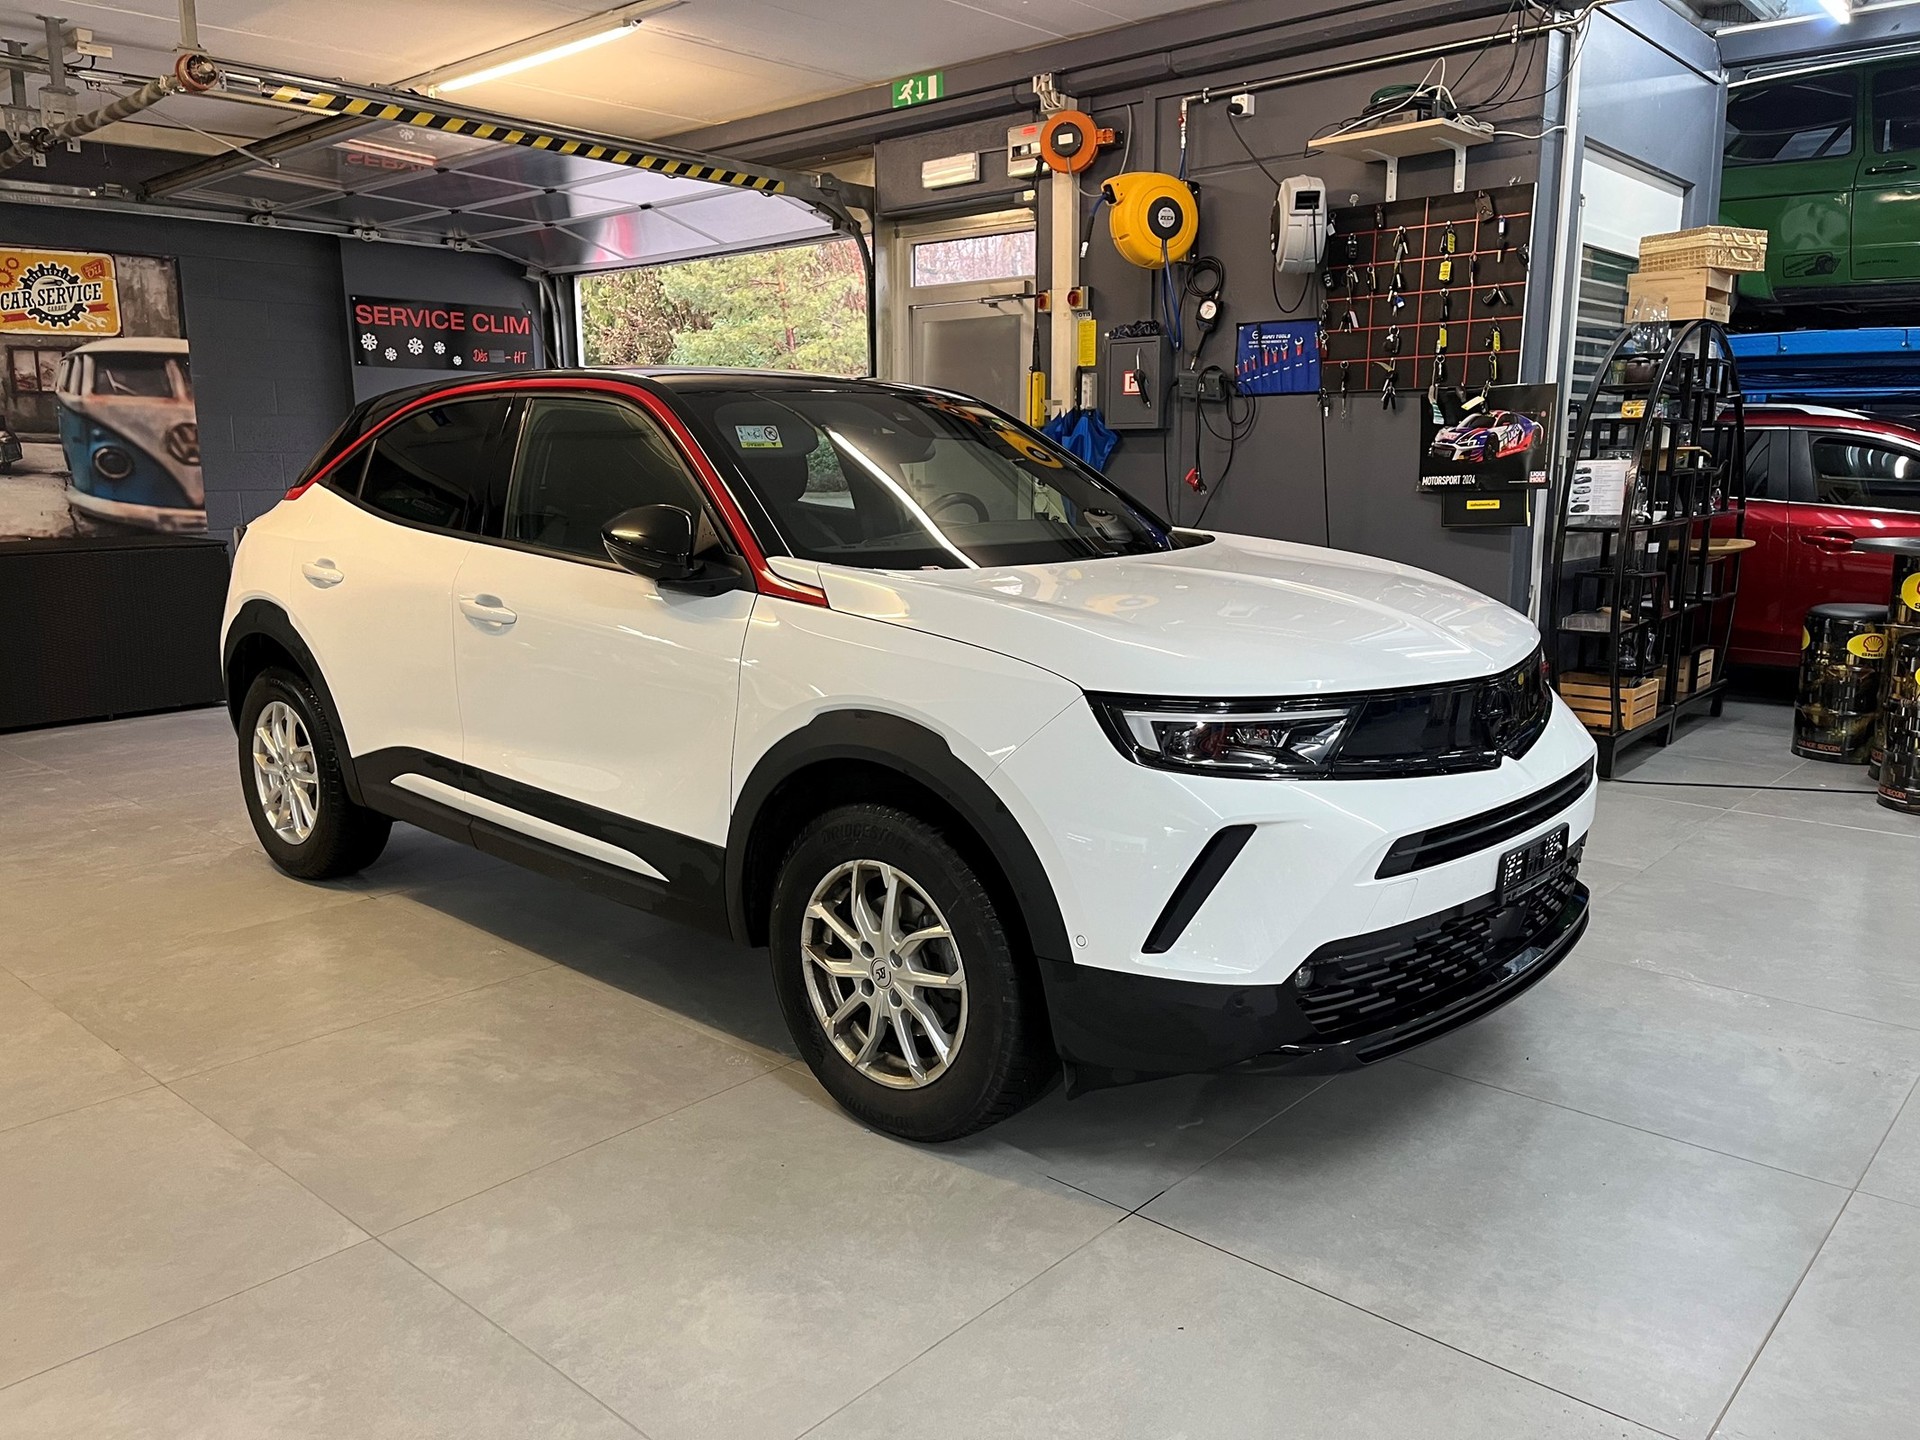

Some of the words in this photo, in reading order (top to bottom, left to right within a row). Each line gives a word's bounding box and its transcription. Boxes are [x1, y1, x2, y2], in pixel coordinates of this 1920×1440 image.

[1, 291, 33, 310] CAR
[37, 282, 101, 307] SERVICE
[47, 304, 67, 312] GARAGE
[355, 304, 465, 331] SERVICE
[472, 313, 530, 335] CLIM
[514, 351, 527, 364] HT
[1422, 475, 1461, 485] MOTORSPORT
[1462, 475, 1476, 485] 2024
